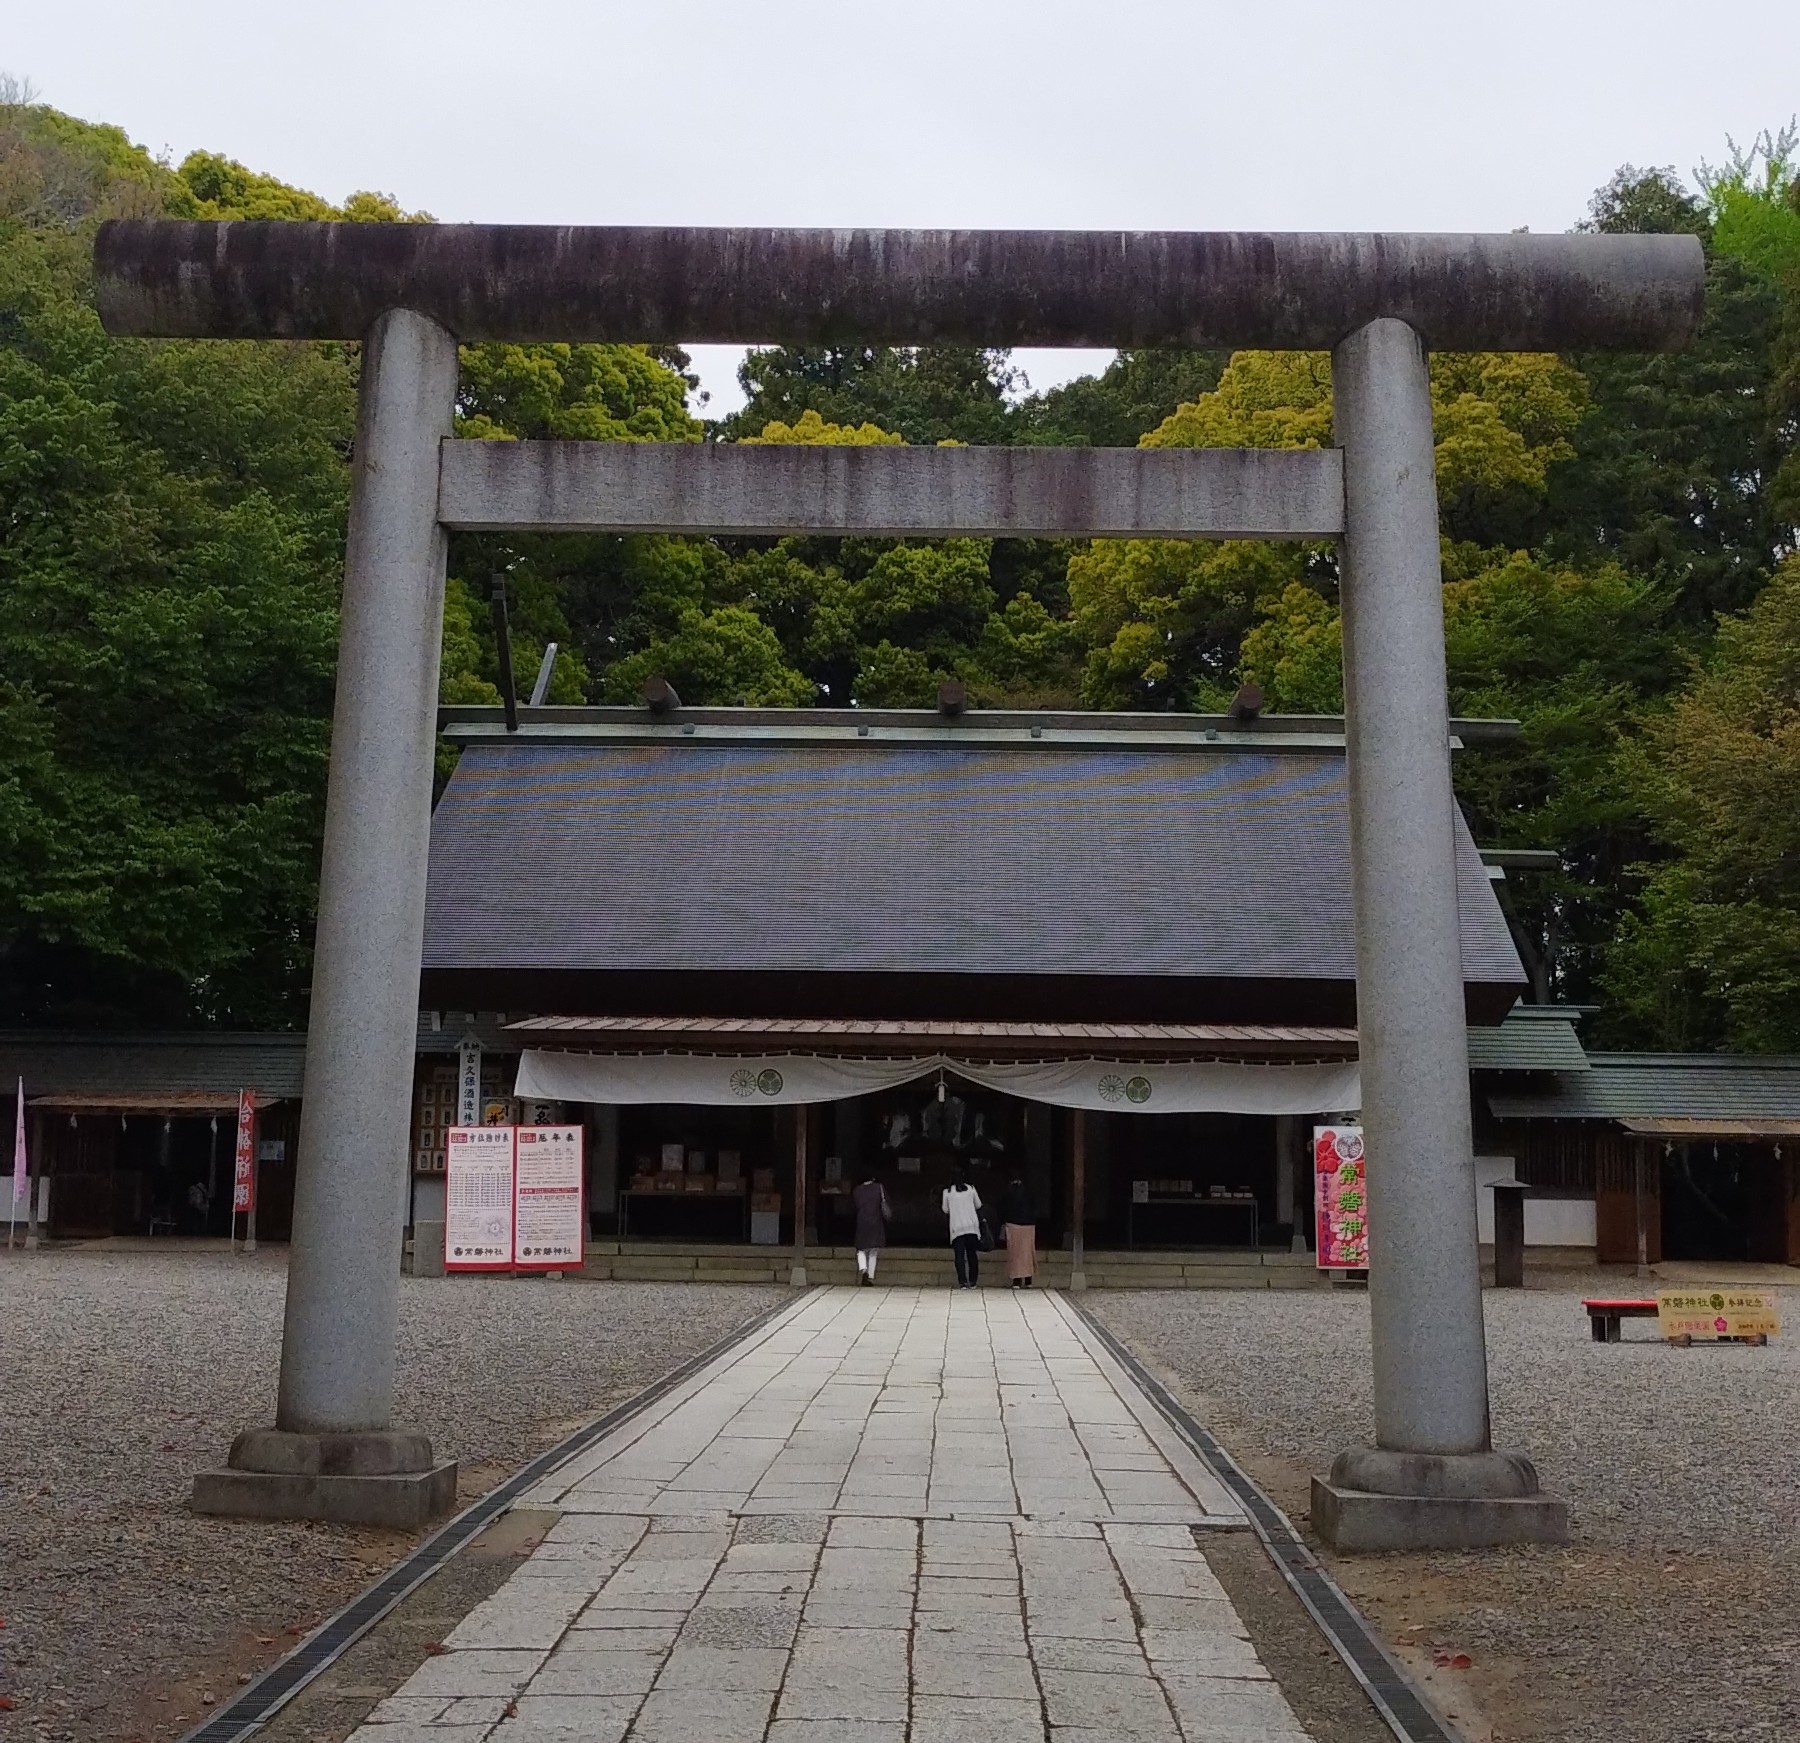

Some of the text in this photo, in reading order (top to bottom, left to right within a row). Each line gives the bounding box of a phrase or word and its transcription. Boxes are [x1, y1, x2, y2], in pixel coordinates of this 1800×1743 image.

[464, 1054, 475, 1126] 吉久保酒造株
[236, 1101, 253, 1205] 合格祈願
[1339, 1165, 1363, 1263] 常磐神社
[1662, 1298, 1709, 1308] 常磐神社
